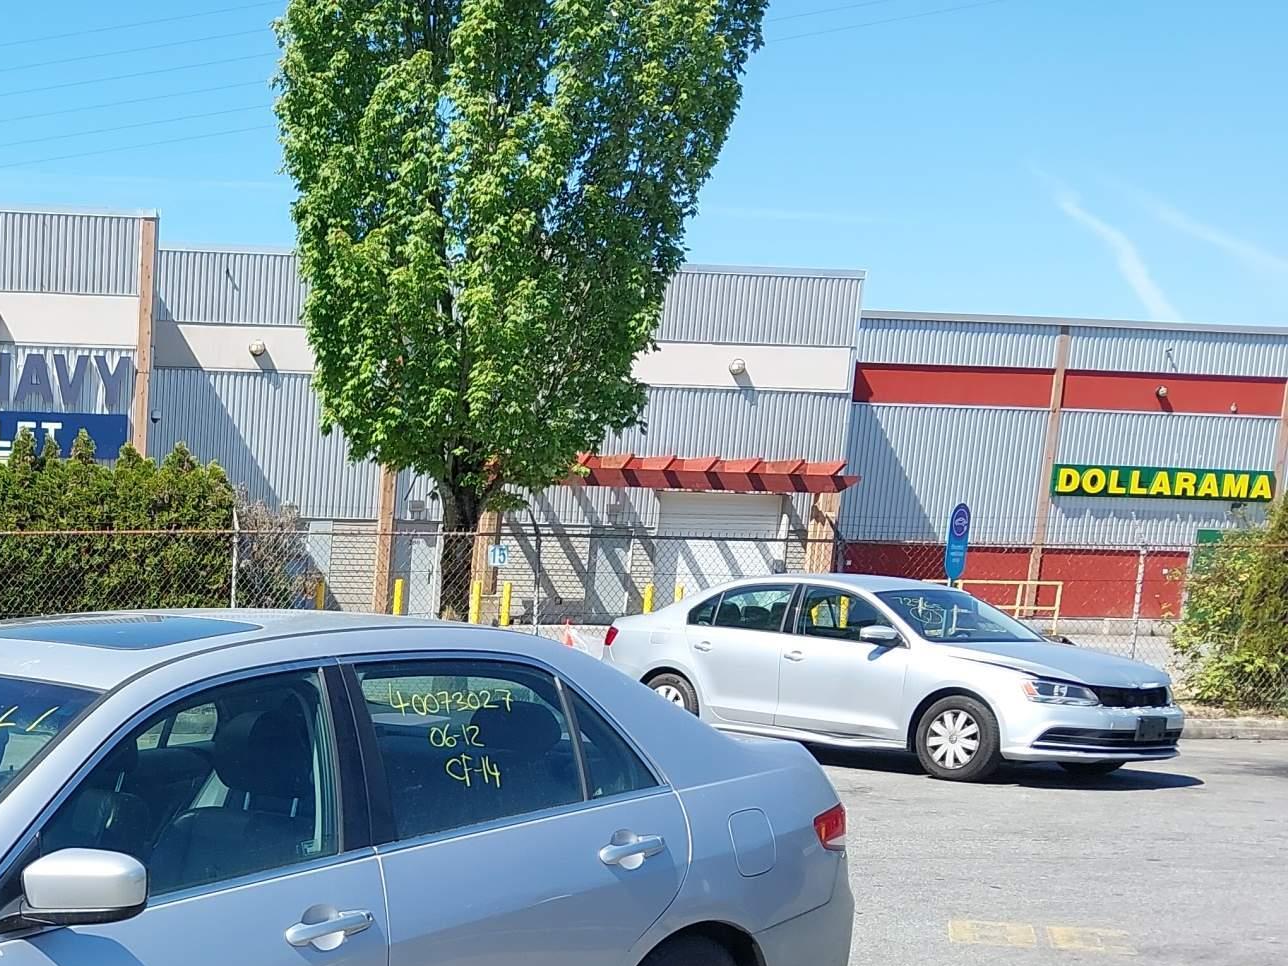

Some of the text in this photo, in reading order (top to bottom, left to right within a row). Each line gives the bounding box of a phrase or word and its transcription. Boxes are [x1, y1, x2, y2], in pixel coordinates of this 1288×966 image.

[1055, 468, 1273, 499] DOLLARAMA
[490, 547, 506, 564] 15
[388, 683, 514, 716] 40073027
[430, 723, 485, 747] 06-12
